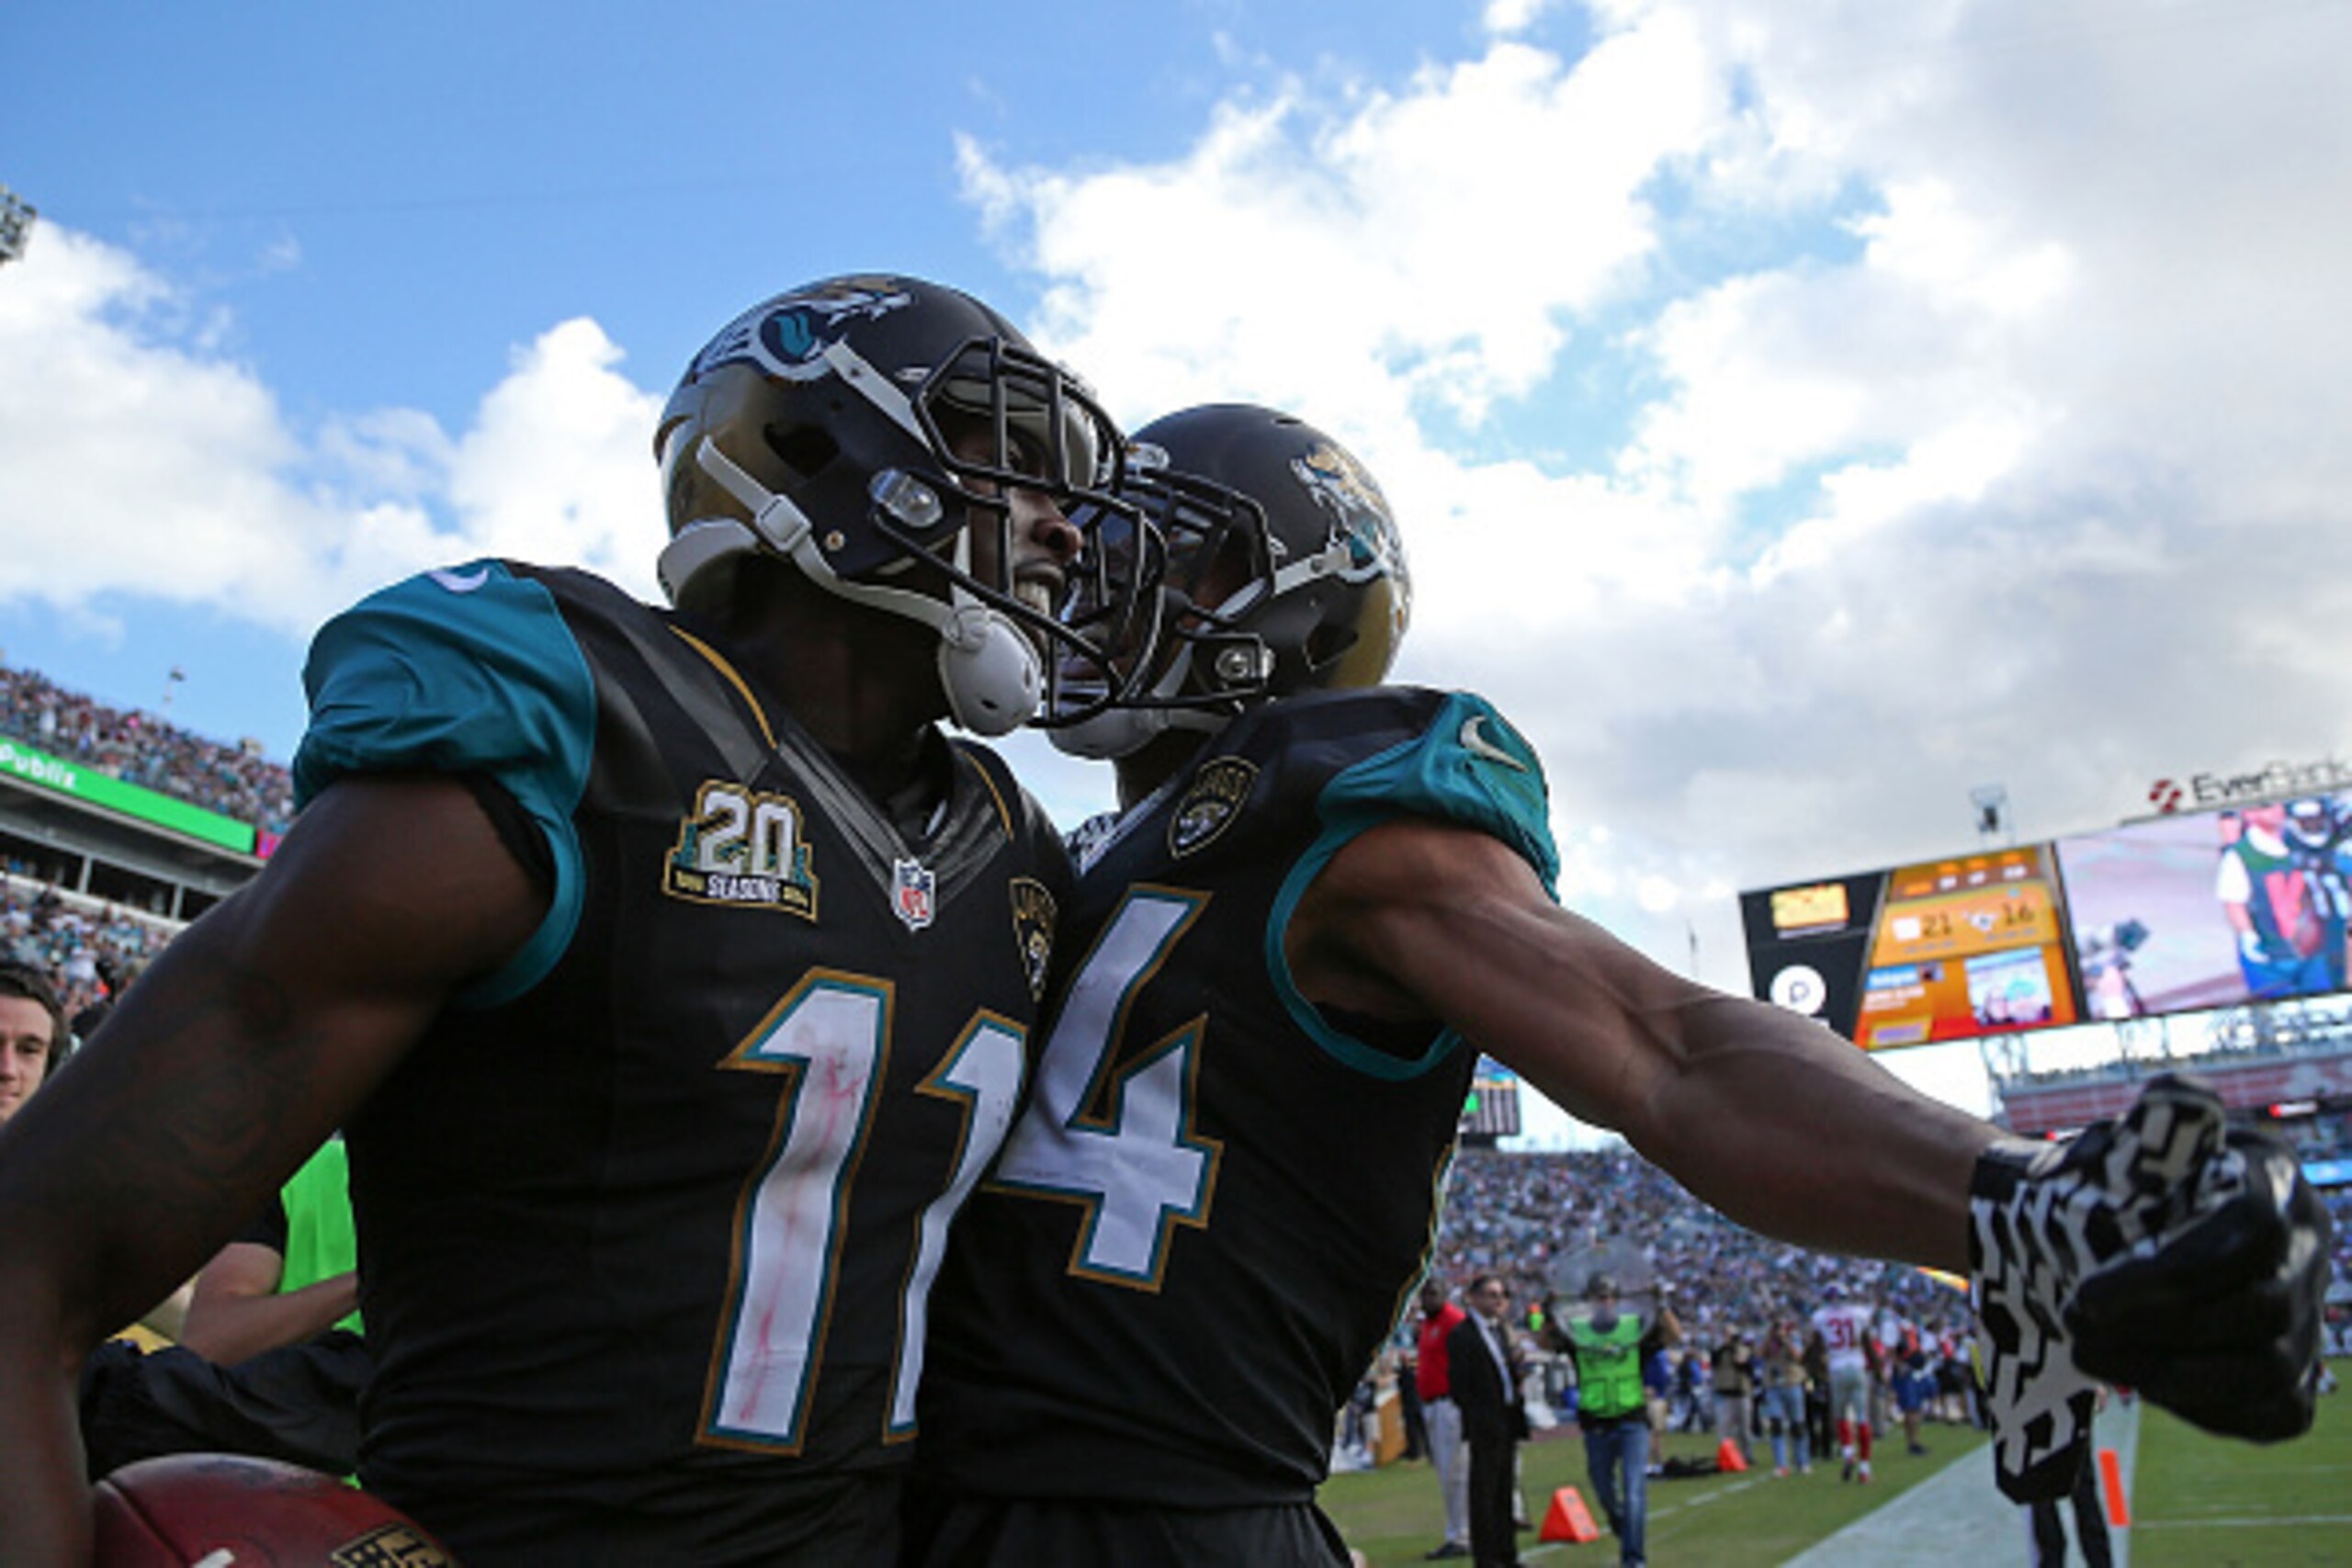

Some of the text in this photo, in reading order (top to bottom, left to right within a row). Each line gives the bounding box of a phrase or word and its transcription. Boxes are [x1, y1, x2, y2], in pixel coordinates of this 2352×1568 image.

[697, 791, 794, 879] 20
[1923, 913, 1952, 938] 21
[695, 966, 1029, 1456] 11
[1828, 1316, 1855, 1350] 31
